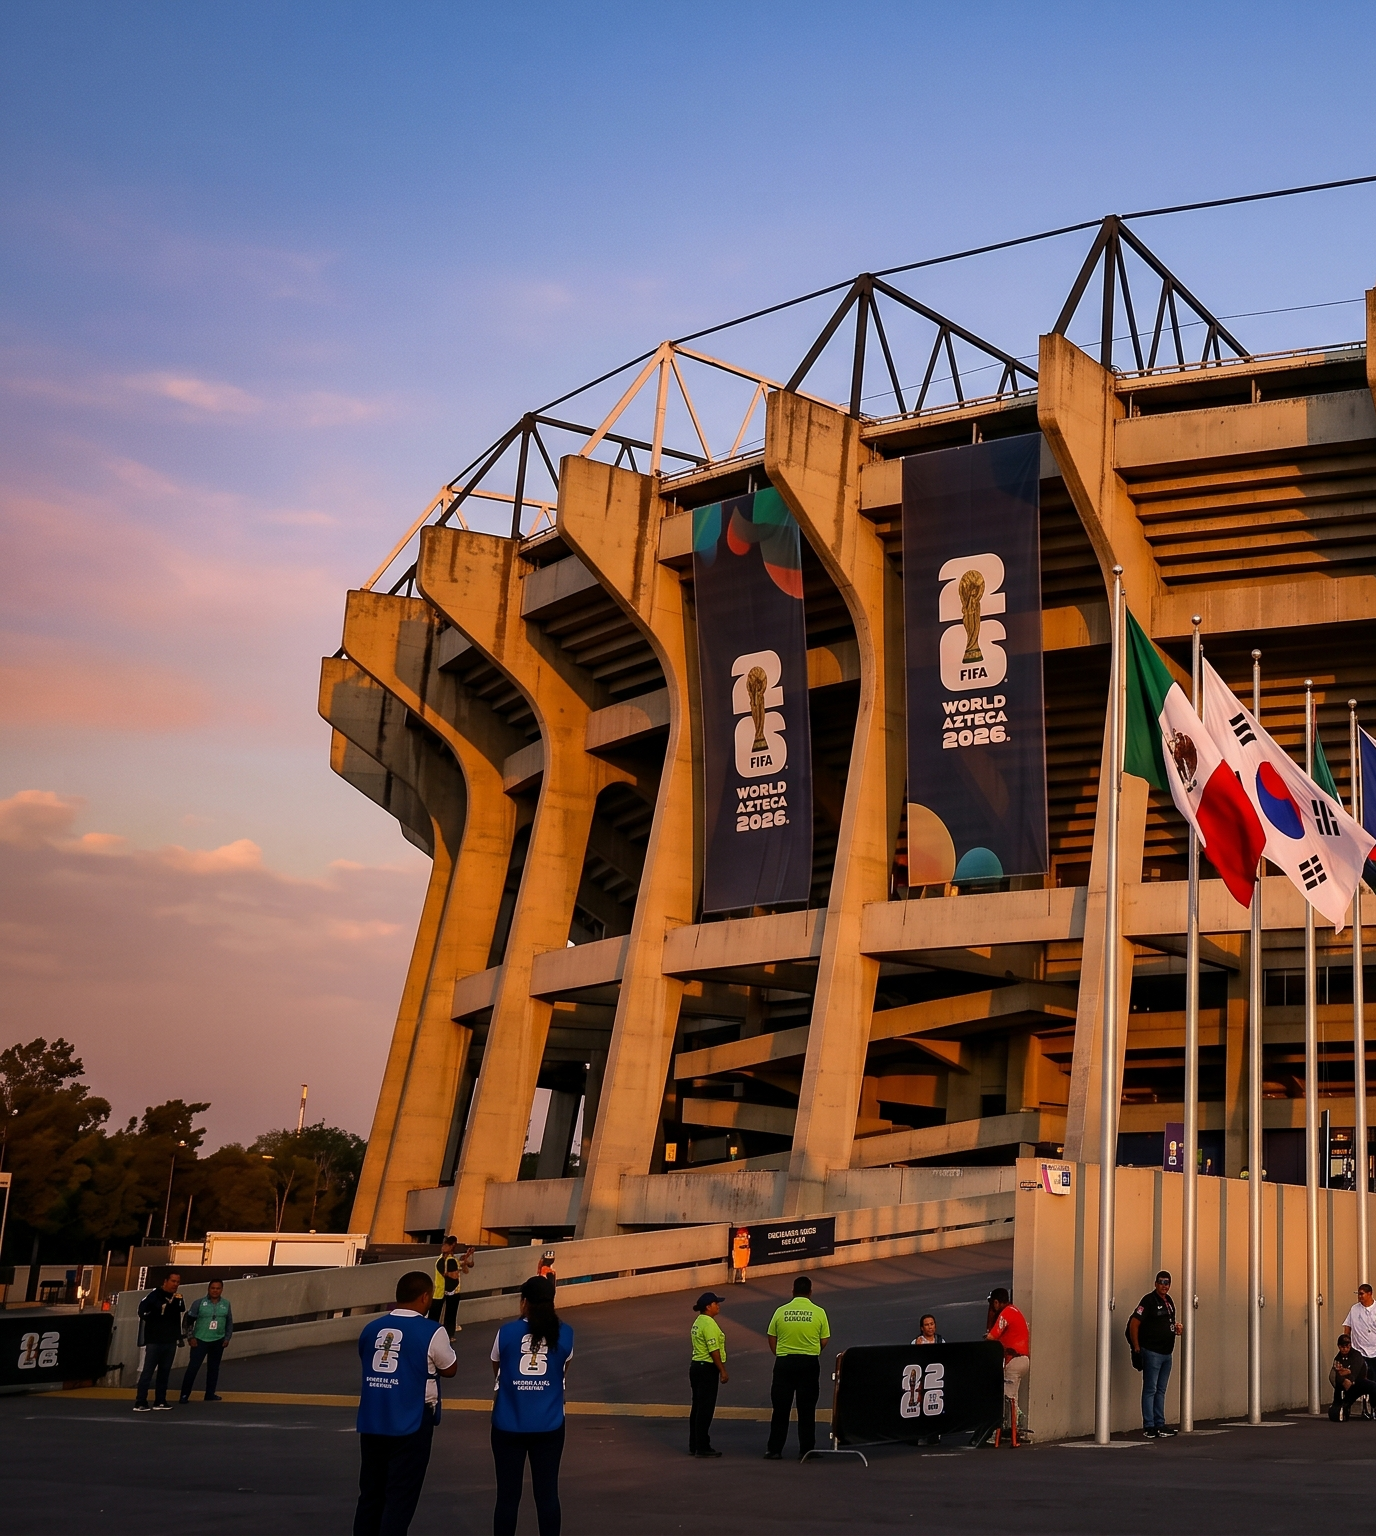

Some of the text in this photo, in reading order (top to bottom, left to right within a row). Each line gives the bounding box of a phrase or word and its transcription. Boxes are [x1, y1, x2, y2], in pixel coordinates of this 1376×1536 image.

[960, 667, 988, 681] FIFA
[942, 695, 1006, 715] WORLD
[942, 710, 1008, 730] AZTECA
[750, 754, 773, 769] FIFA
[736, 781, 787, 800] WORLD
[736, 796, 788, 814] AZTECA
